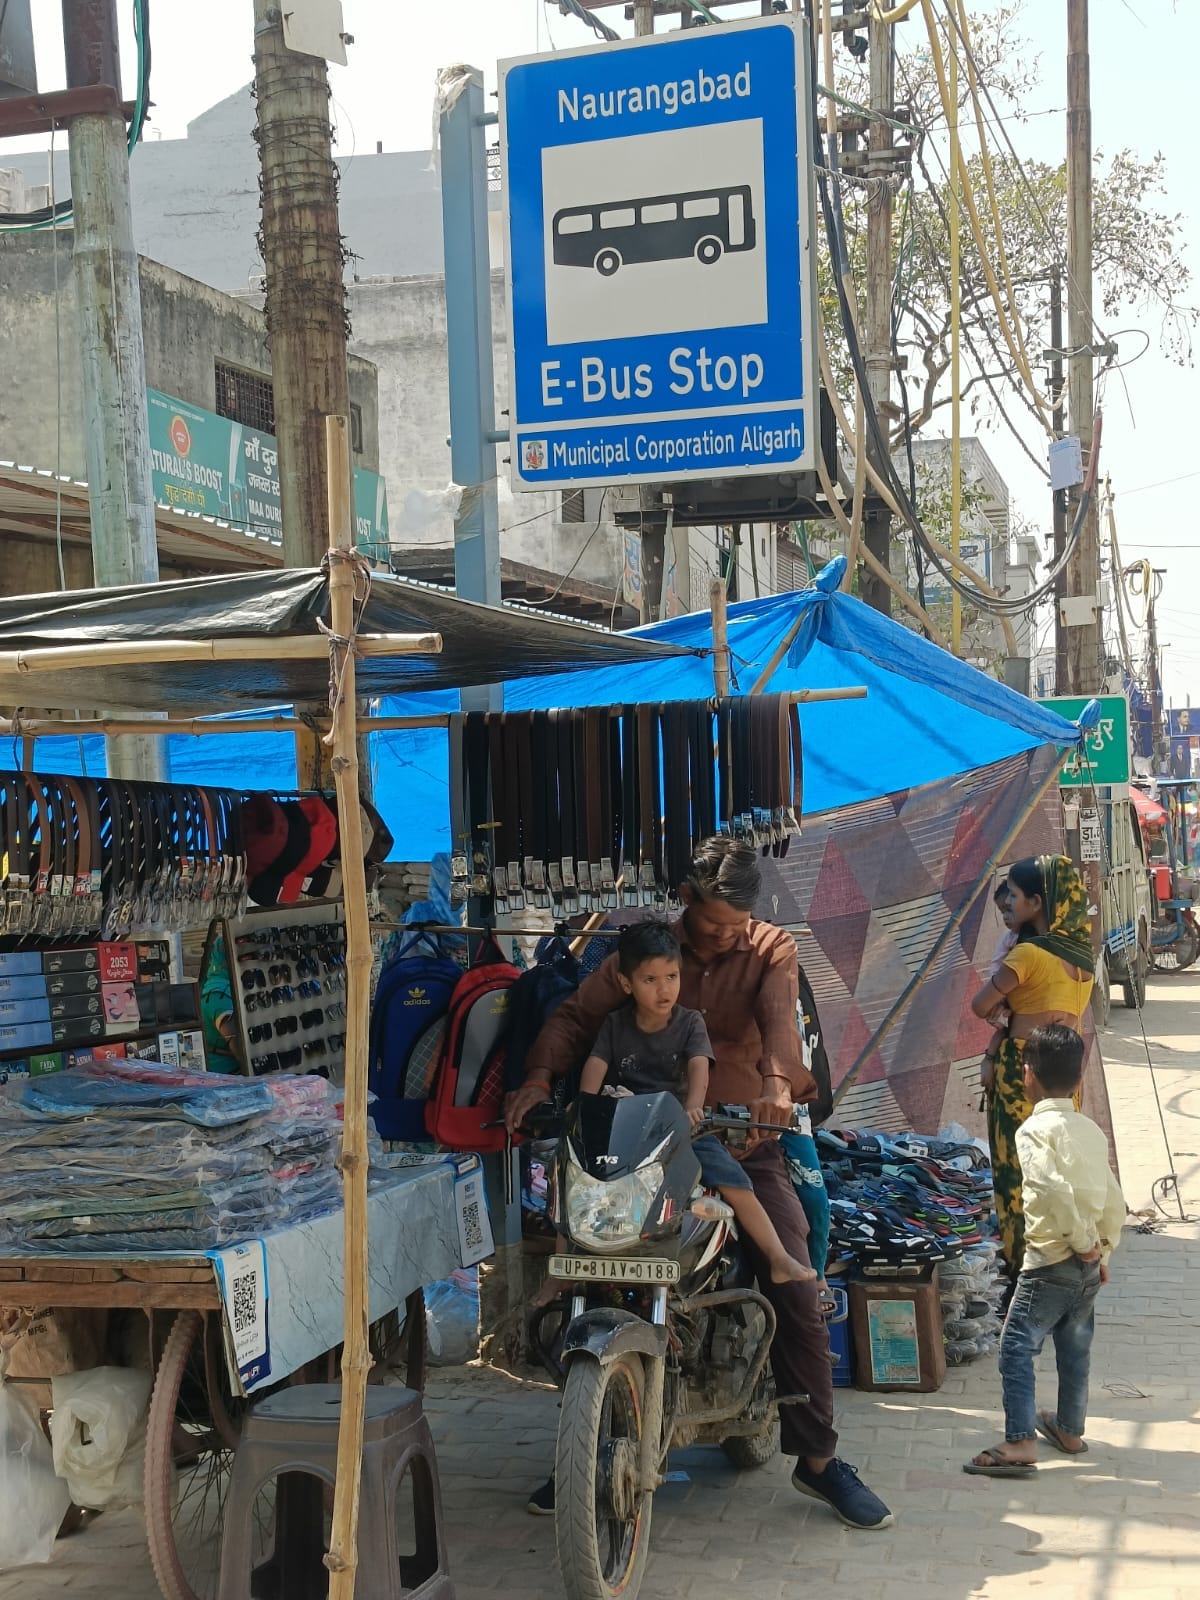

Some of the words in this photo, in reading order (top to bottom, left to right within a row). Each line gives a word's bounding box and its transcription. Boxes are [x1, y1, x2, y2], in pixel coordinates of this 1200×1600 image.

[557, 61, 752, 124] Naurangabad
[541, 355, 653, 407] E-Bus
[668, 345, 764, 398] Stop
[553, 433, 631, 469] Municipal
[635, 429, 735, 466] Corporation
[740, 422, 802, 458] Aligarh
[150, 448, 192, 482] ATURAL'S
[194, 463, 223, 492] BOOST
[248, 498, 264, 518] MAA
[265, 504, 282, 523] DUR
[110, 956, 129, 968] 2053
[595, 1155, 619, 1165] TVS
